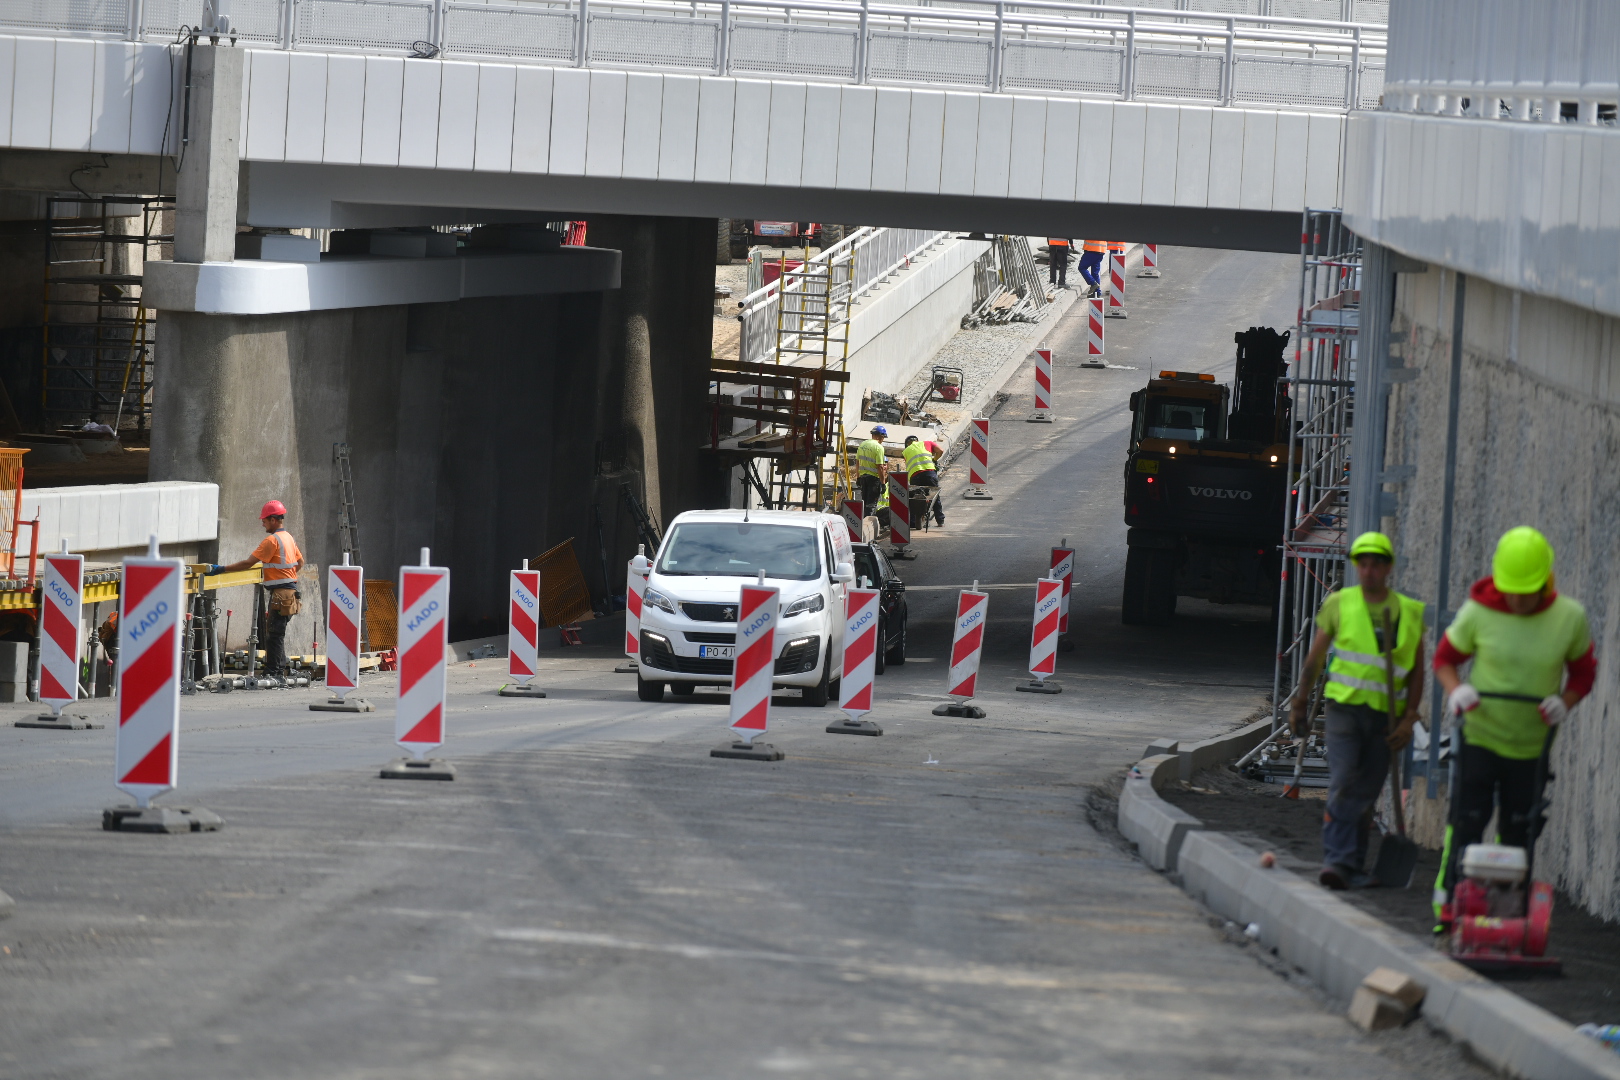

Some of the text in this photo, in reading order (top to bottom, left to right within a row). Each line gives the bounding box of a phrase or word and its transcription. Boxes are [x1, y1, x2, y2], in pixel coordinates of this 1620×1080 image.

[891, 484, 906, 498] KADO
[1188, 485, 1253, 501] VOLVO
[845, 513, 859, 528] KADO
[1053, 563, 1070, 578] KADO
[49, 580, 74, 607] KADO
[333, 587, 355, 610] KADO
[515, 588, 535, 609] KADO
[1039, 598, 1057, 613] KADO
[129, 601, 168, 641] KADO
[407, 600, 440, 632] KADO
[743, 611, 771, 637] KADO
[849, 611, 873, 632] KADO
[960, 611, 983, 629] KADO
[722, 647, 736, 658] 4J
